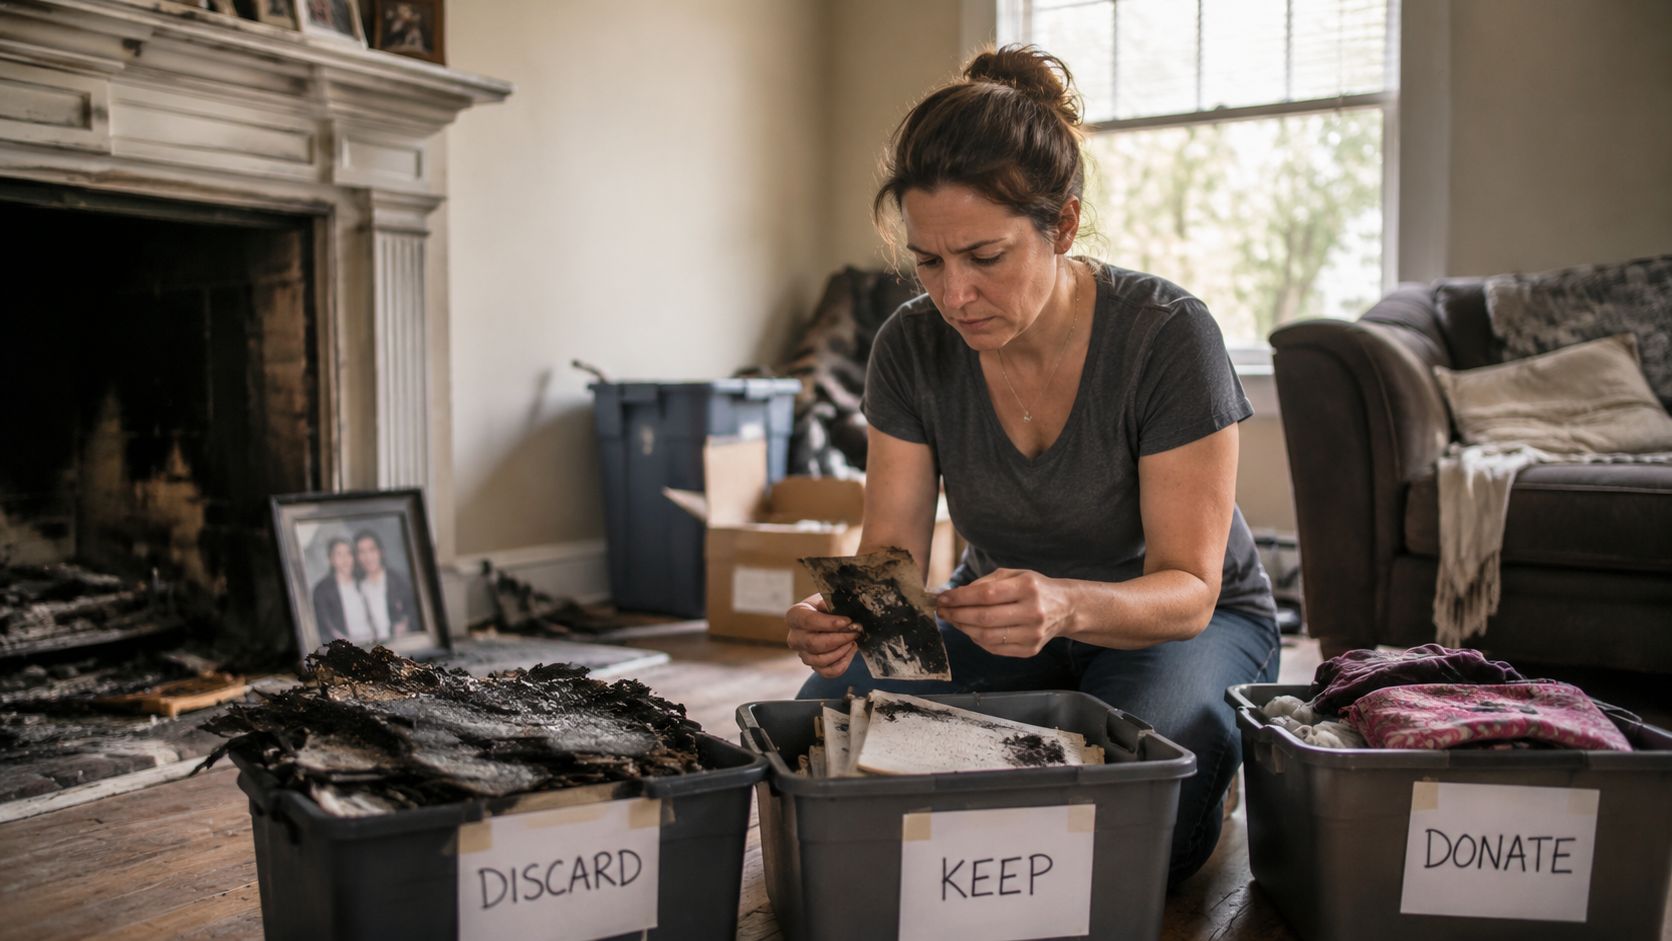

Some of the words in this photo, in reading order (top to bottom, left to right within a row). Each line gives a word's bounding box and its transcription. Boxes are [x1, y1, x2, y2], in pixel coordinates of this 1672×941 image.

[1423, 828, 1577, 875] DONATE
[477, 849, 642, 910] DISCARD
[941, 853, 1054, 901] KEEP
